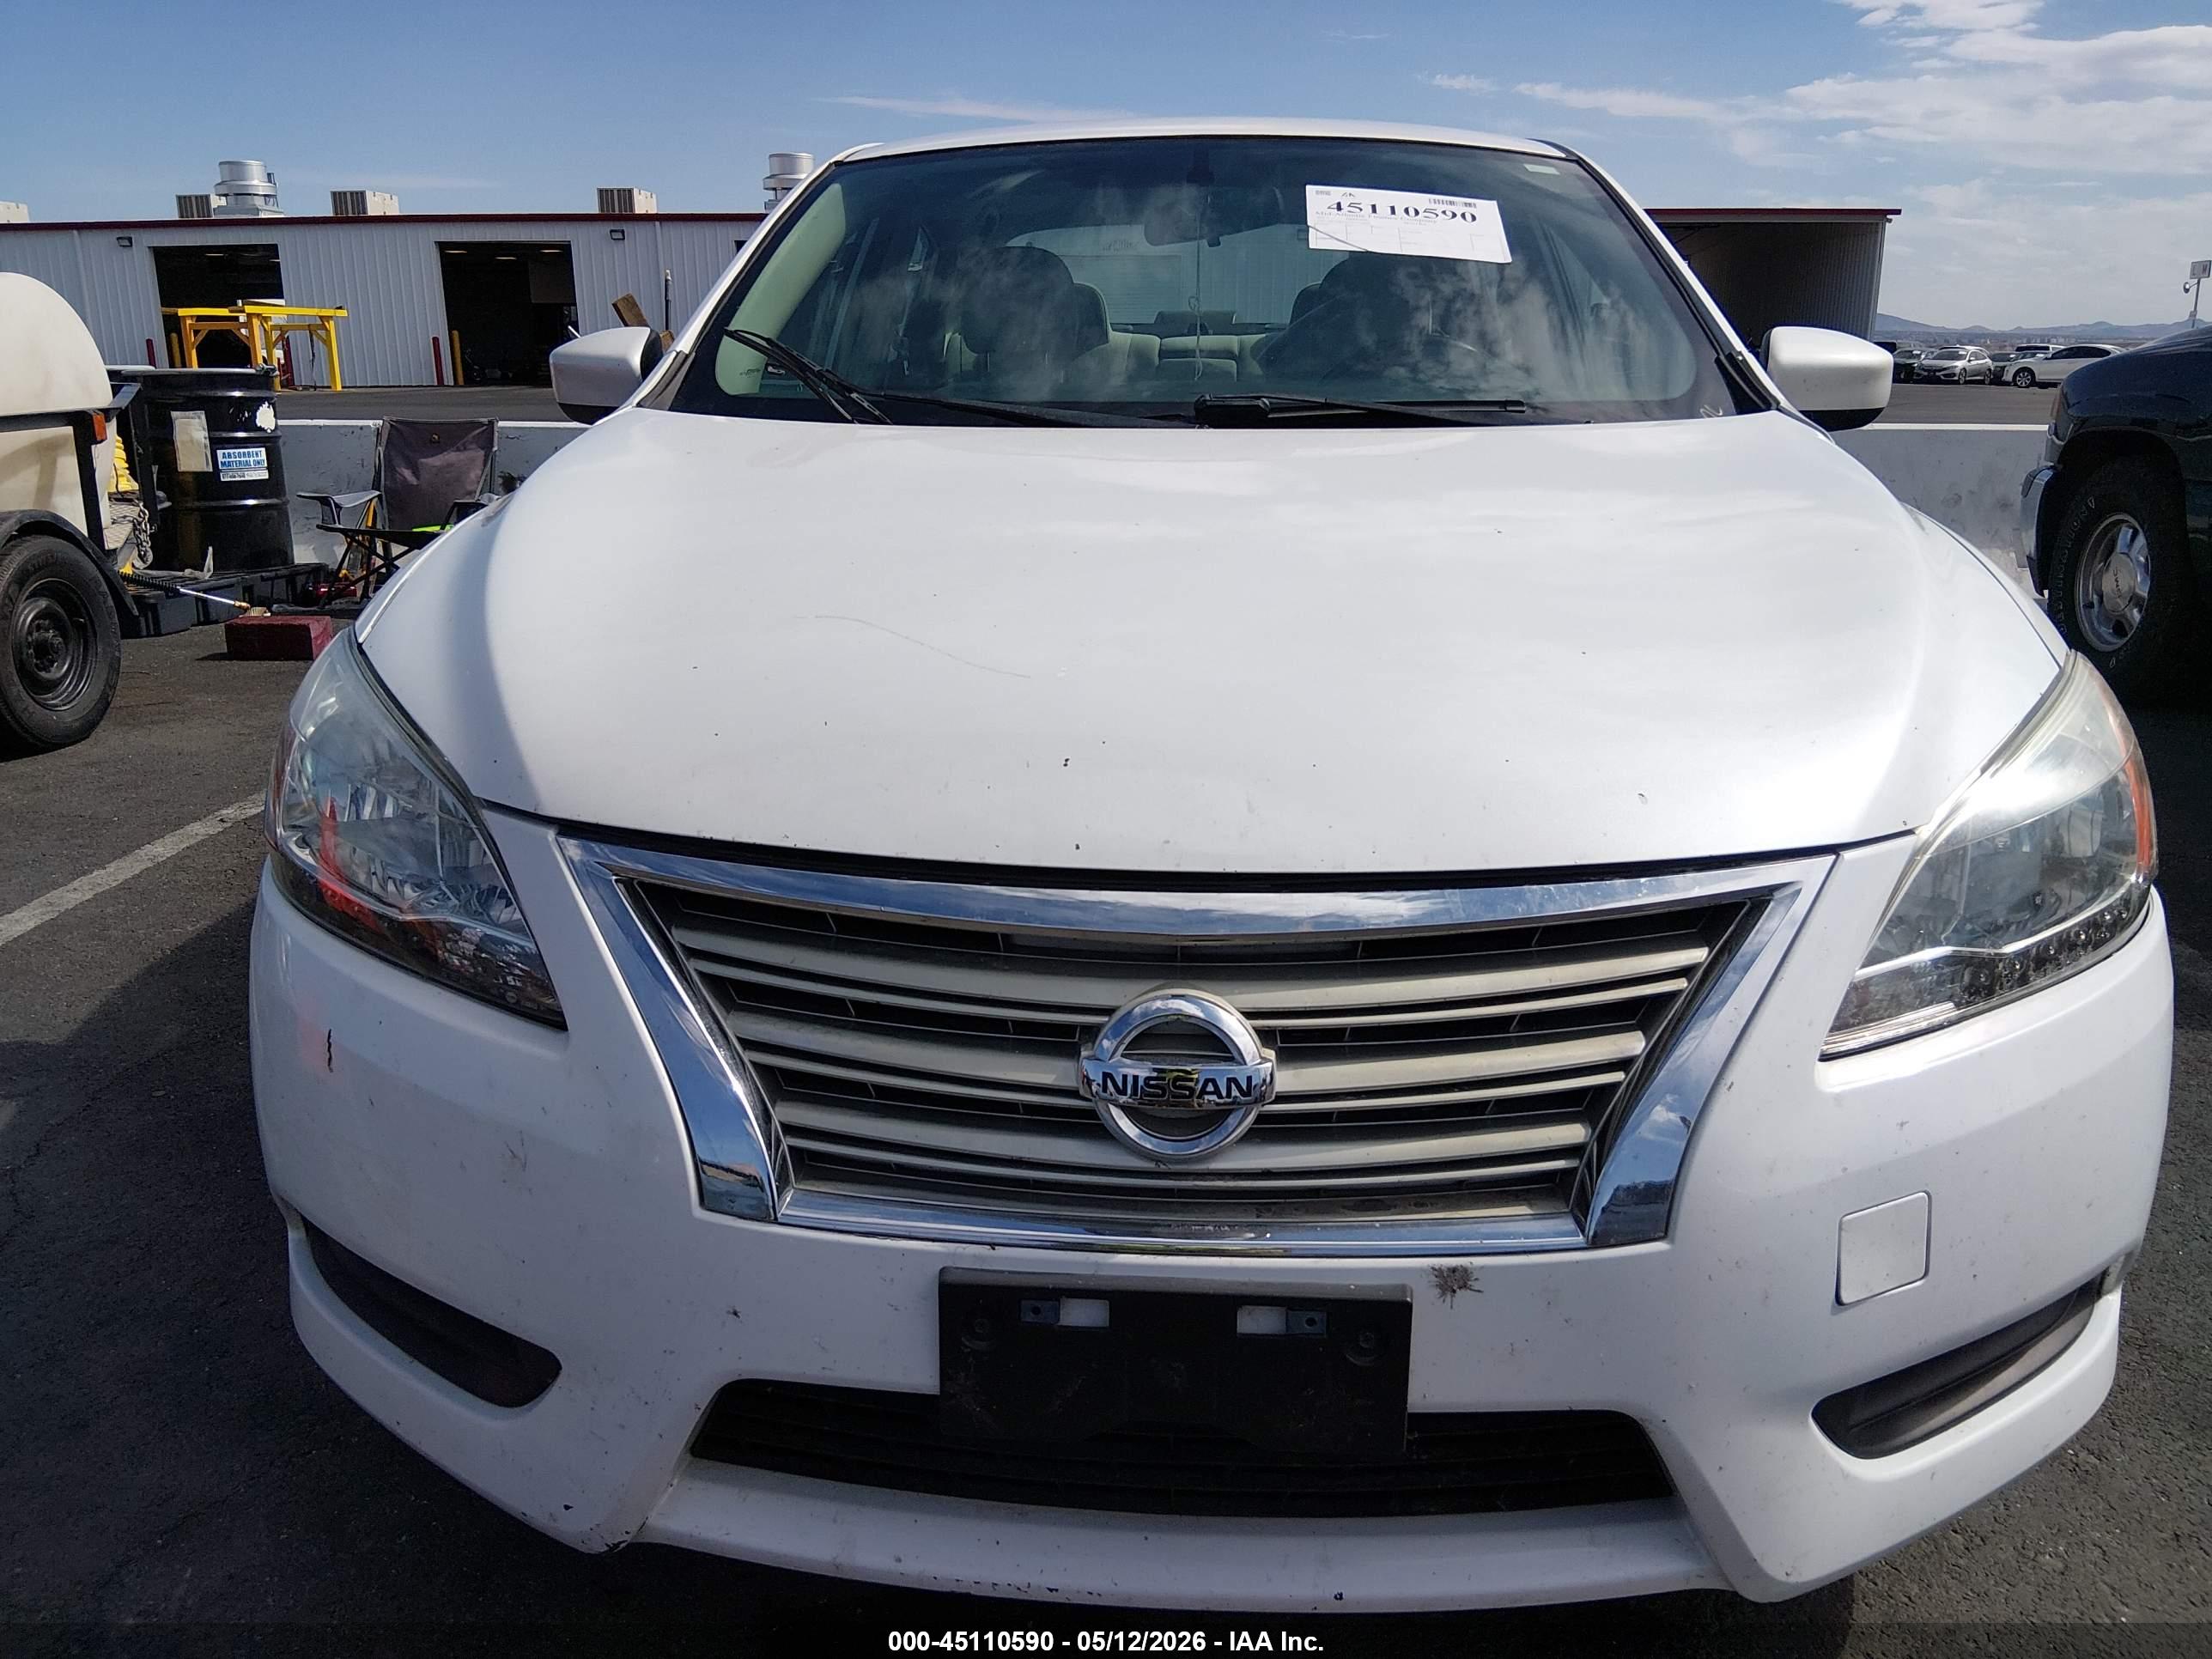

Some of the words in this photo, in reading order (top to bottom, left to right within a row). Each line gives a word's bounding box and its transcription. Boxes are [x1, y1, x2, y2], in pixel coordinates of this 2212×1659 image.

[1327, 201, 1477, 223] 45110590
[221, 459, 252, 468] MATERIAL
[252, 459, 265, 467] ONLY
[1102, 1072, 1253, 1100] NISSAN
